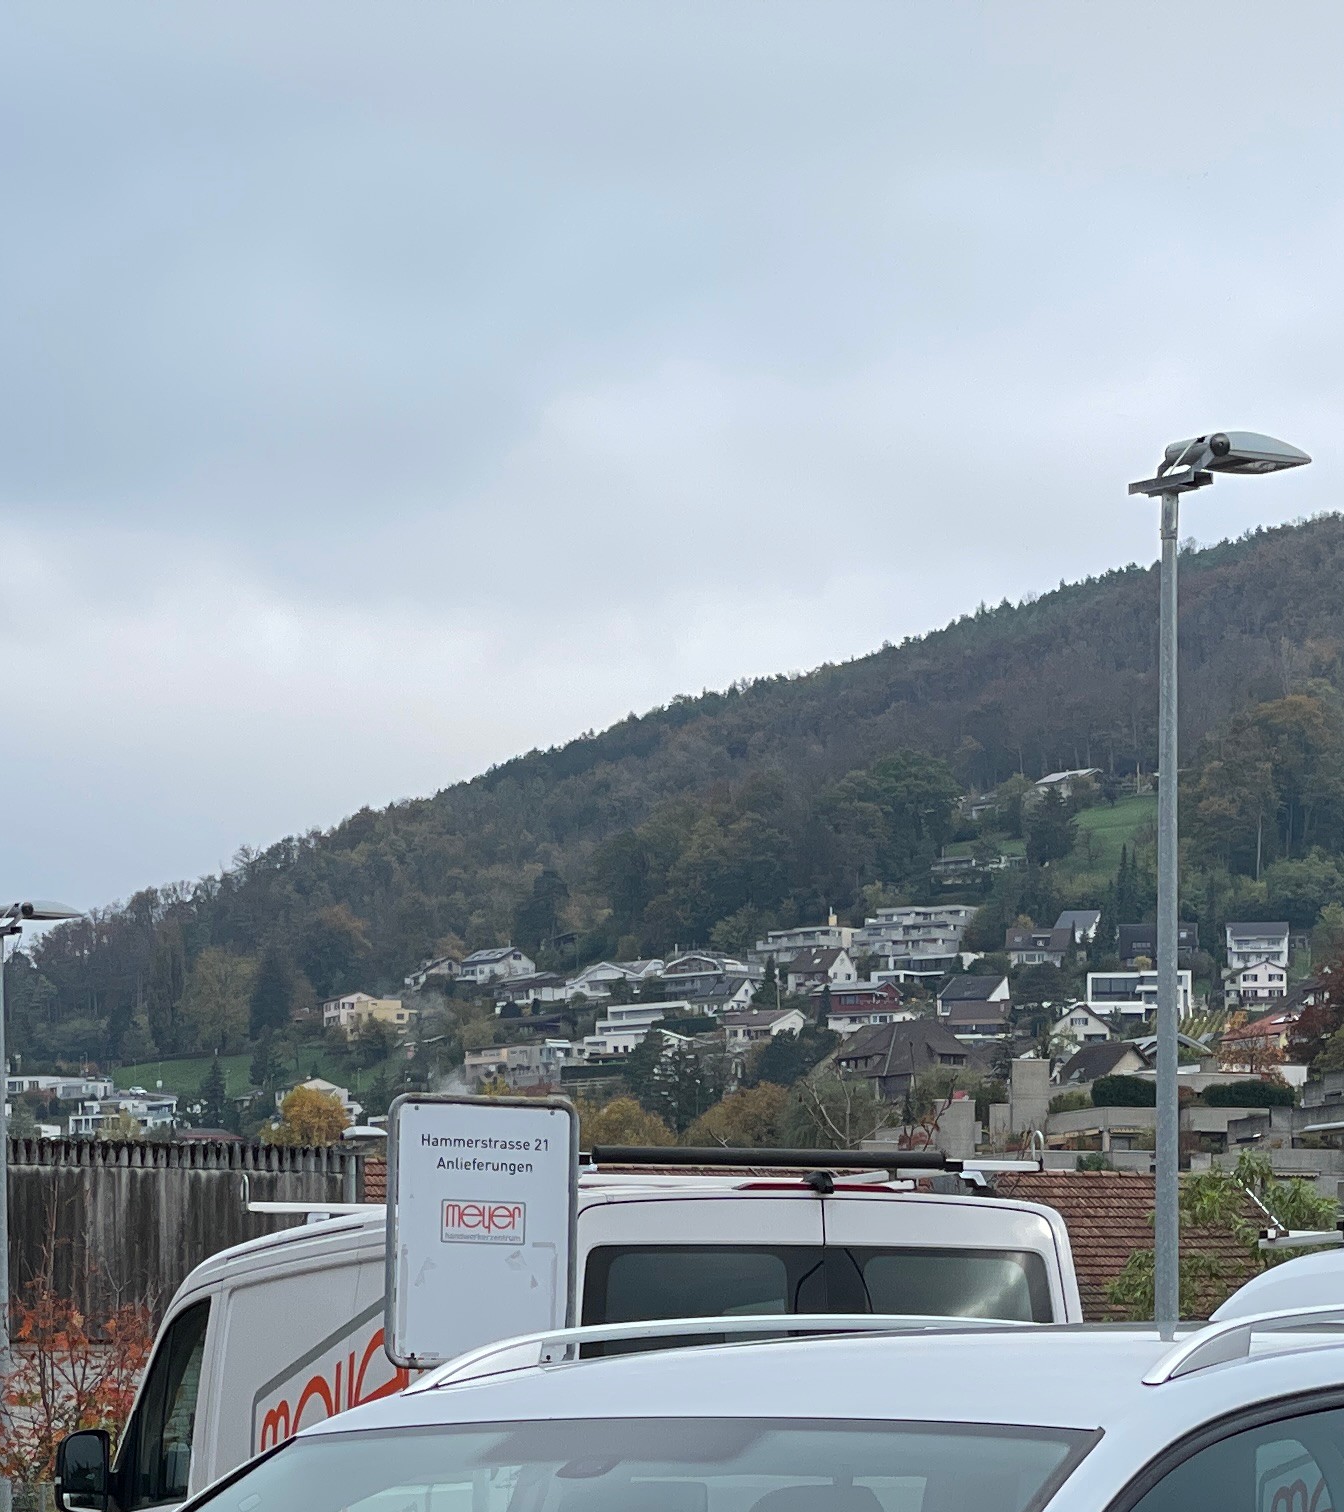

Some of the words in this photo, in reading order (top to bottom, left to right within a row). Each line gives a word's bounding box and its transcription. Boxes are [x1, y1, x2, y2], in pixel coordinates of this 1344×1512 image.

[421, 1133, 530, 1150] Hammerstrasse
[534, 1138, 549, 1151] 21
[436, 1157, 533, 1175] Anlieferungen
[446, 1204, 521, 1233] meyer
